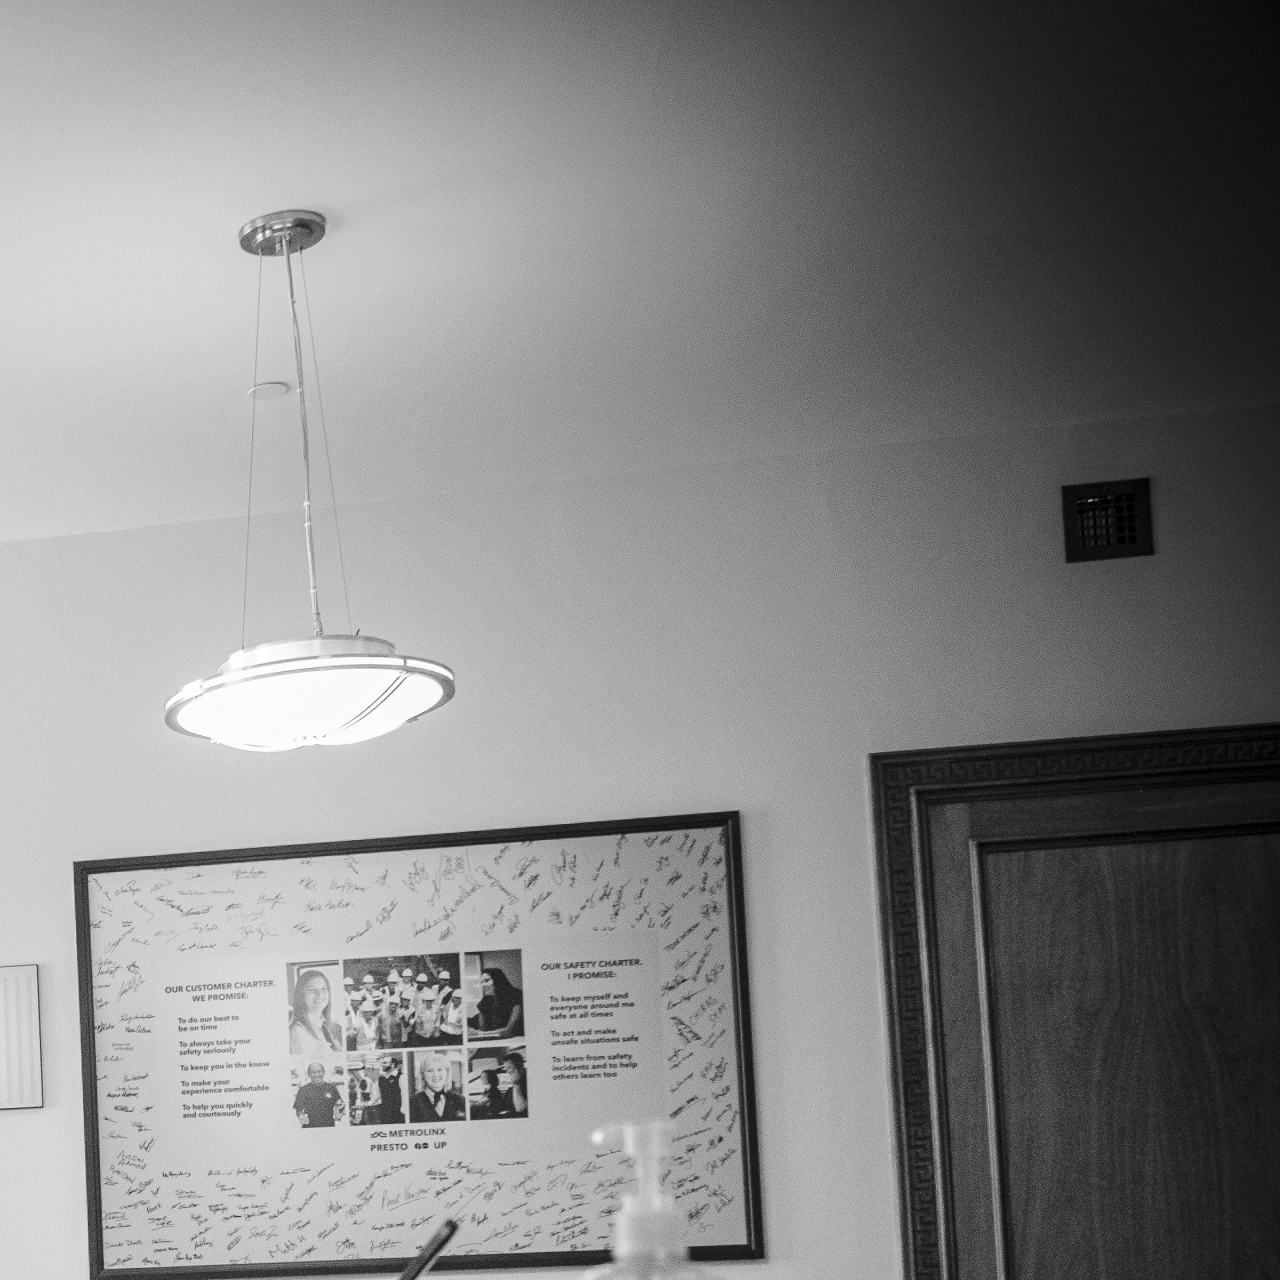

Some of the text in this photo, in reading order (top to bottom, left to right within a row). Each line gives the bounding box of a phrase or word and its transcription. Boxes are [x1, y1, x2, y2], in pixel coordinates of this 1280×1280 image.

[563, 961, 596, 969] SAFETY
[573, 971, 616, 979] PROMISE:
[185, 982, 232, 992] CUSTOMER
[208, 993, 249, 1001] PROMISE:
[584, 993, 610, 1002] myself
[622, 1034, 639, 1042] safe
[191, 1064, 208, 1072] keep
[181, 1088, 222, 1096] experience
[226, 1101, 253, 1109] quickly
[198, 1110, 241, 1118] courteously
[389, 1128, 446, 1137] METROLINX
[371, 1143, 408, 1151] PRESTO
